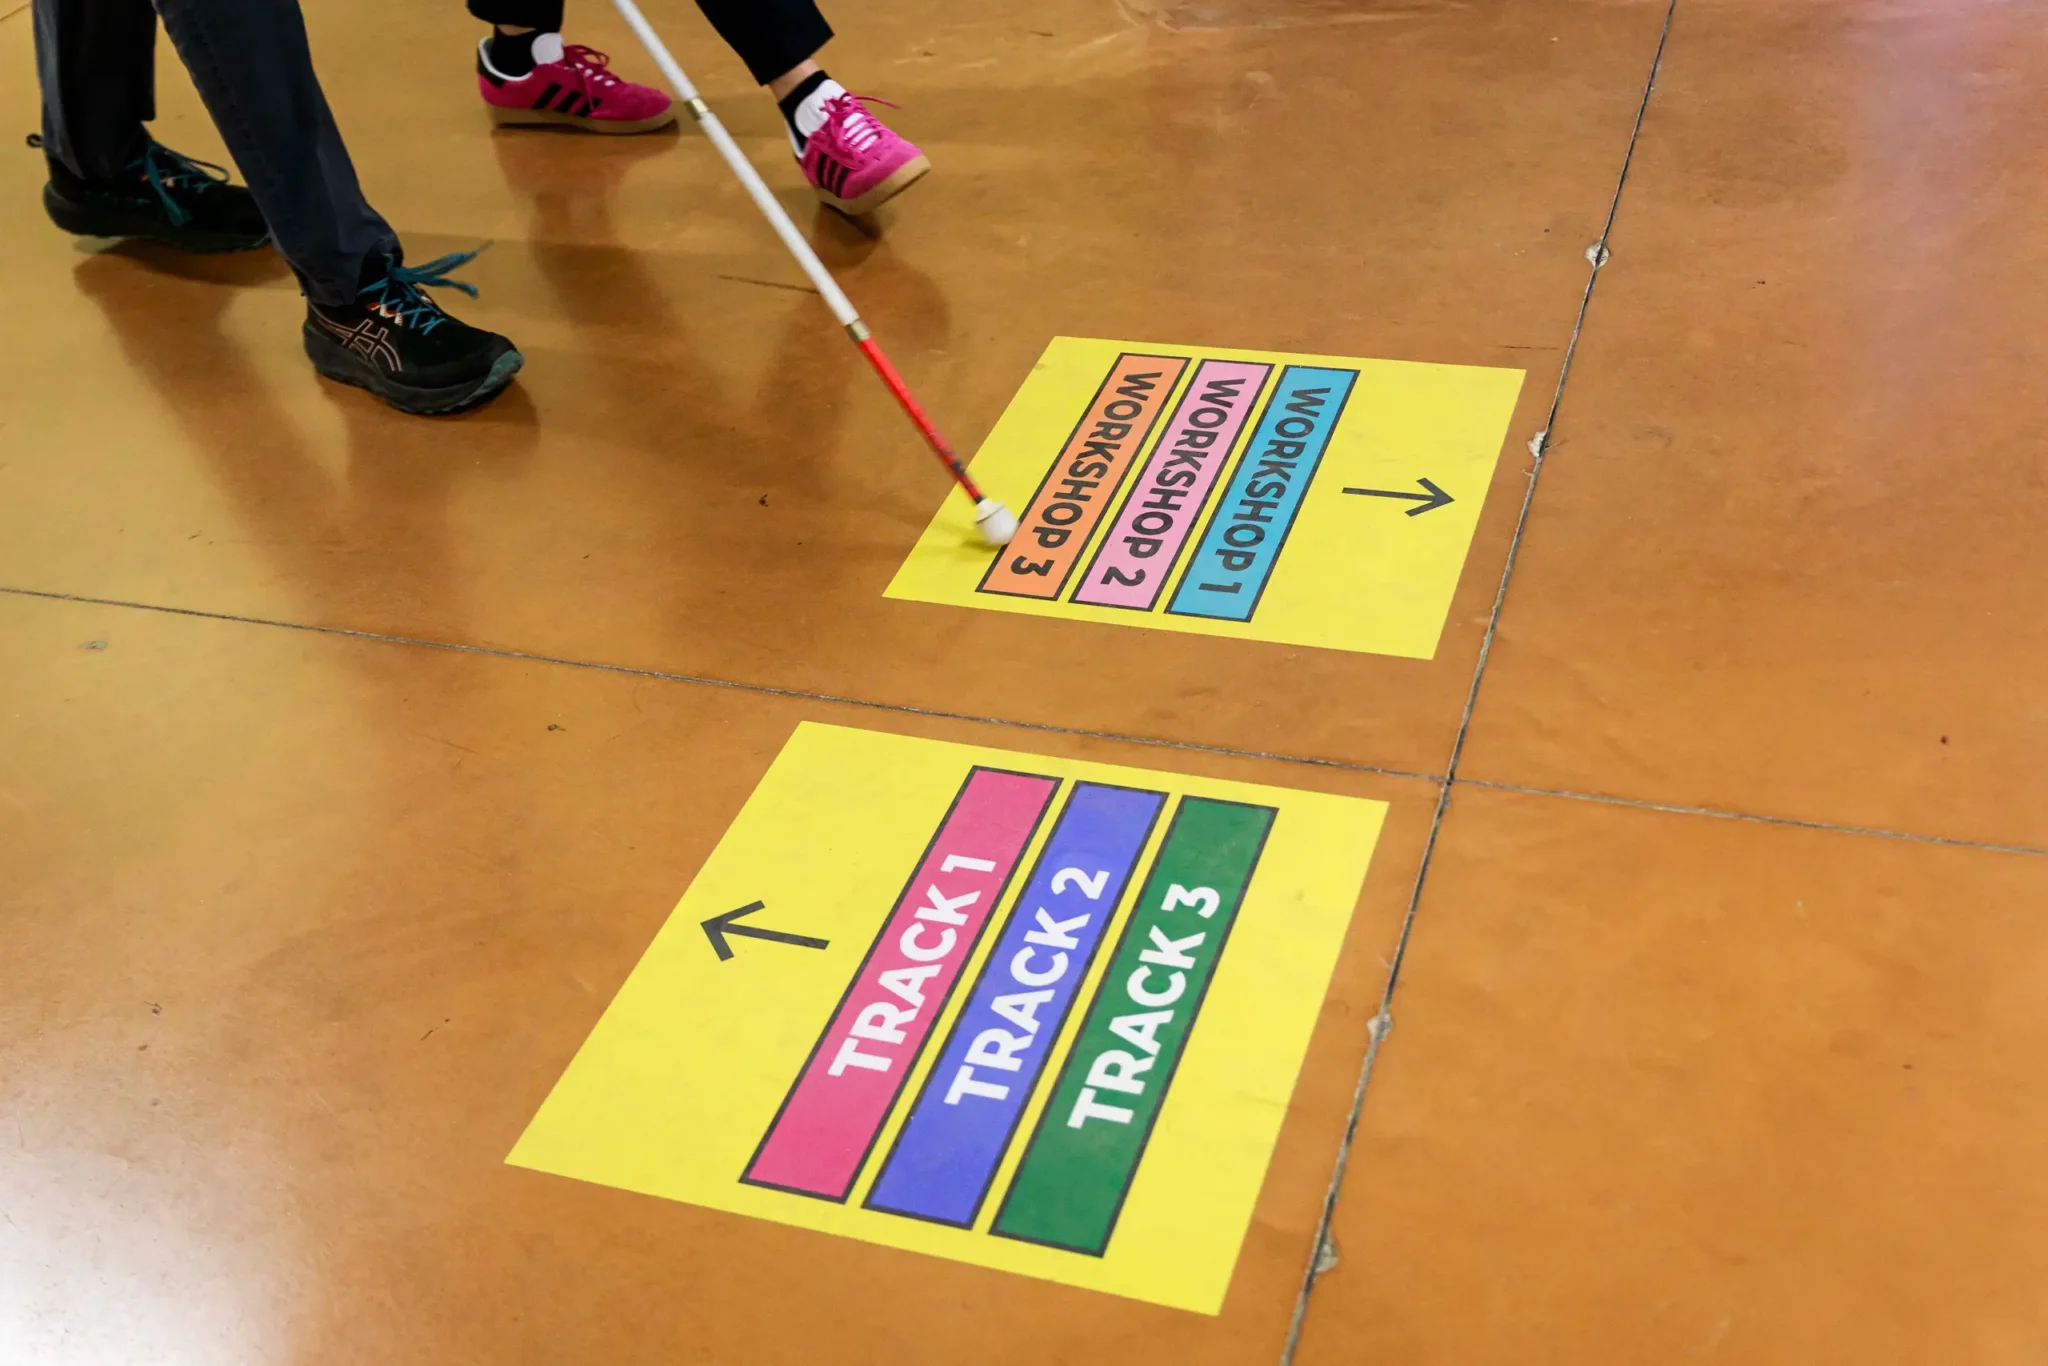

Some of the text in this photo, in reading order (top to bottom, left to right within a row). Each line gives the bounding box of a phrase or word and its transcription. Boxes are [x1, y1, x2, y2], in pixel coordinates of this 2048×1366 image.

[1010, 372, 1162, 577] WORKSHOP 3
[1100, 378, 1246, 587] WORKSHOP 2
[1198, 387, 1332, 595] WORKSHOP 1
[828, 854, 997, 1077] TRACK 1
[943, 867, 1111, 1105] TRACK 2
[1067, 883, 1220, 1129] TRACK 3
